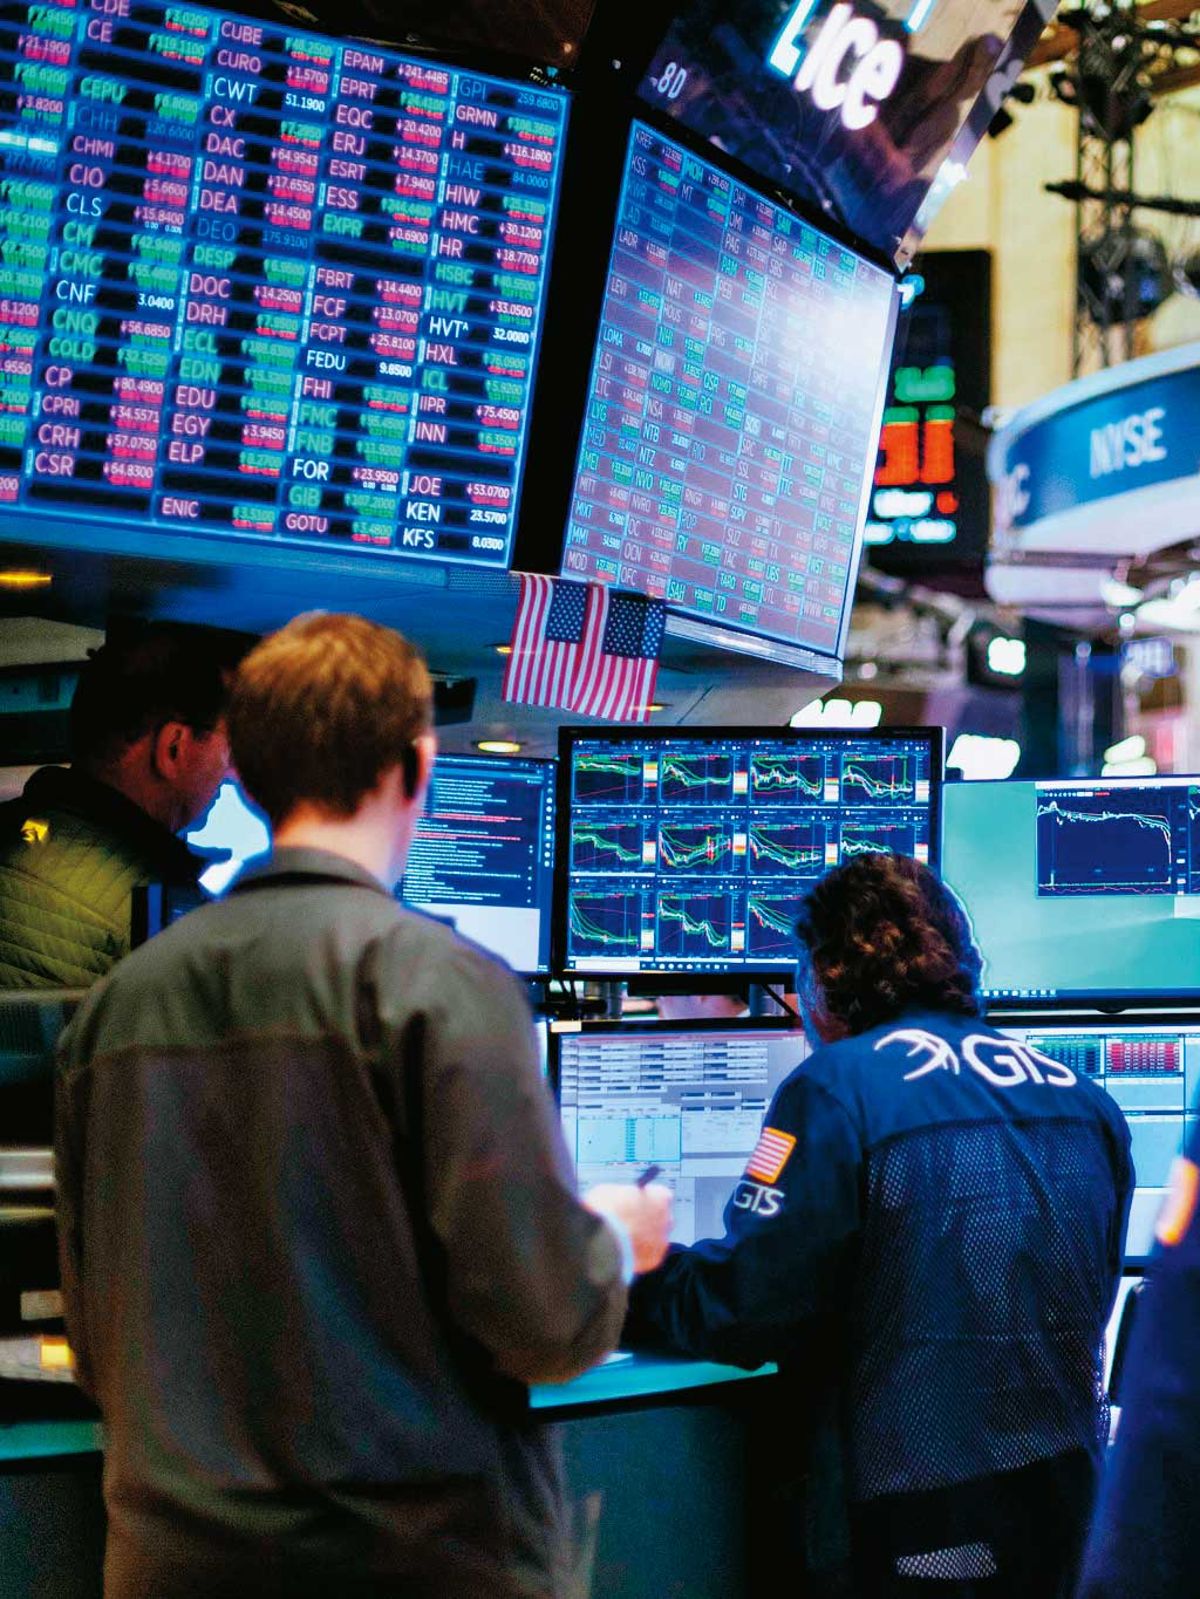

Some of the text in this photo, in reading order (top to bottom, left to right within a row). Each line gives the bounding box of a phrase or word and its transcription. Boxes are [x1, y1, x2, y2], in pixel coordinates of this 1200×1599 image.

[87, 19, 113, 43] CE
[220, 20, 263, 46] CUBE
[217, 49, 329, 85] CURO 1.5700
[344, 50, 384, 73] EPAM
[80, 76, 128, 104] CEPU
[214, 77, 258, 104] CWT
[285, 93, 326, 112] 51.1900
[340, 77, 377, 99] EPRT
[459, 78, 487, 100] GPI
[209, 105, 236, 128] CX
[336, 104, 374, 130] EQC
[403, 121, 442, 138] 20.4200
[456, 105, 497, 128] GRMN
[73, 135, 191, 168] CHMI 4.1700
[206, 133, 246, 159] DAC
[333, 131, 438, 165] ERJ 14.3700
[452, 131, 465, 150] H
[70, 163, 187, 197] CIO 5.6600
[203, 161, 244, 187] DAN
[329, 159, 435, 191] ESRT 7.9400
[449, 160, 484, 181] HAE
[200, 189, 238, 214] DEA
[326, 186, 358, 210] ESS
[446, 184, 480, 206] HIW
[66, 192, 184, 224] CLS 15.8400
[63, 221, 95, 247] CM
[197, 217, 236, 242] DEO
[323, 213, 364, 237] EXPR
[442, 210, 479, 234] HMC
[506, 224, 542, 240] 30.1200
[193, 244, 236, 270] DESP
[439, 236, 539, 266] HR 18.7700
[60, 251, 103, 278] CMC
[435, 262, 474, 285] HSBC
[56, 280, 174, 310] CNF 3.0400
[190, 273, 231, 297] DOC
[316, 269, 422, 297] FBRT 14.4400
[52, 308, 98, 336] CNQ
[186, 302, 228, 326] DRH
[313, 296, 419, 325] FCF 13.0700
[496, 302, 532, 318] 33.0500
[49, 337, 95, 361] COLD
[184, 329, 218, 354] ECL
[310, 323, 347, 342] FCPT
[376, 336, 415, 352] 25.8100
[307, 350, 346, 371] FEDU
[426, 344, 458, 365] HXL
[45, 366, 73, 387] CP
[121, 379, 164, 395] 80.4900
[179, 358, 221, 384] EDN
[421, 370, 448, 391] ICL
[175, 385, 216, 409] EDU
[303, 377, 332, 399] FHI
[42, 395, 80, 416] CPRI
[300, 404, 337, 427] FMC
[419, 396, 520, 422] IIPR 75.4500
[38, 423, 80, 448] CRH
[114, 435, 156, 451] 57.0750
[172, 413, 211, 437] EGY
[416, 422, 446, 444] INN
[642, 422, 660, 443] NTB
[168, 441, 204, 463] ELP
[297, 431, 333, 455] FNB
[1089, 407, 1168, 479] NYSE
[35, 452, 153, 479] CSR 64.8300
[639, 446, 656, 467] NTZ
[293, 458, 399, 484] FOR 23.9500
[289, 485, 320, 508] GIB
[409, 476, 510, 499] JOE 53.0700
[161, 498, 199, 518] ENIC
[406, 502, 441, 523] KEN
[286, 513, 328, 533] GOTU
[403, 529, 435, 549] KFS
[960, 1033, 1078, 1088] GTS
[734, 1181, 785, 1216] GTS
